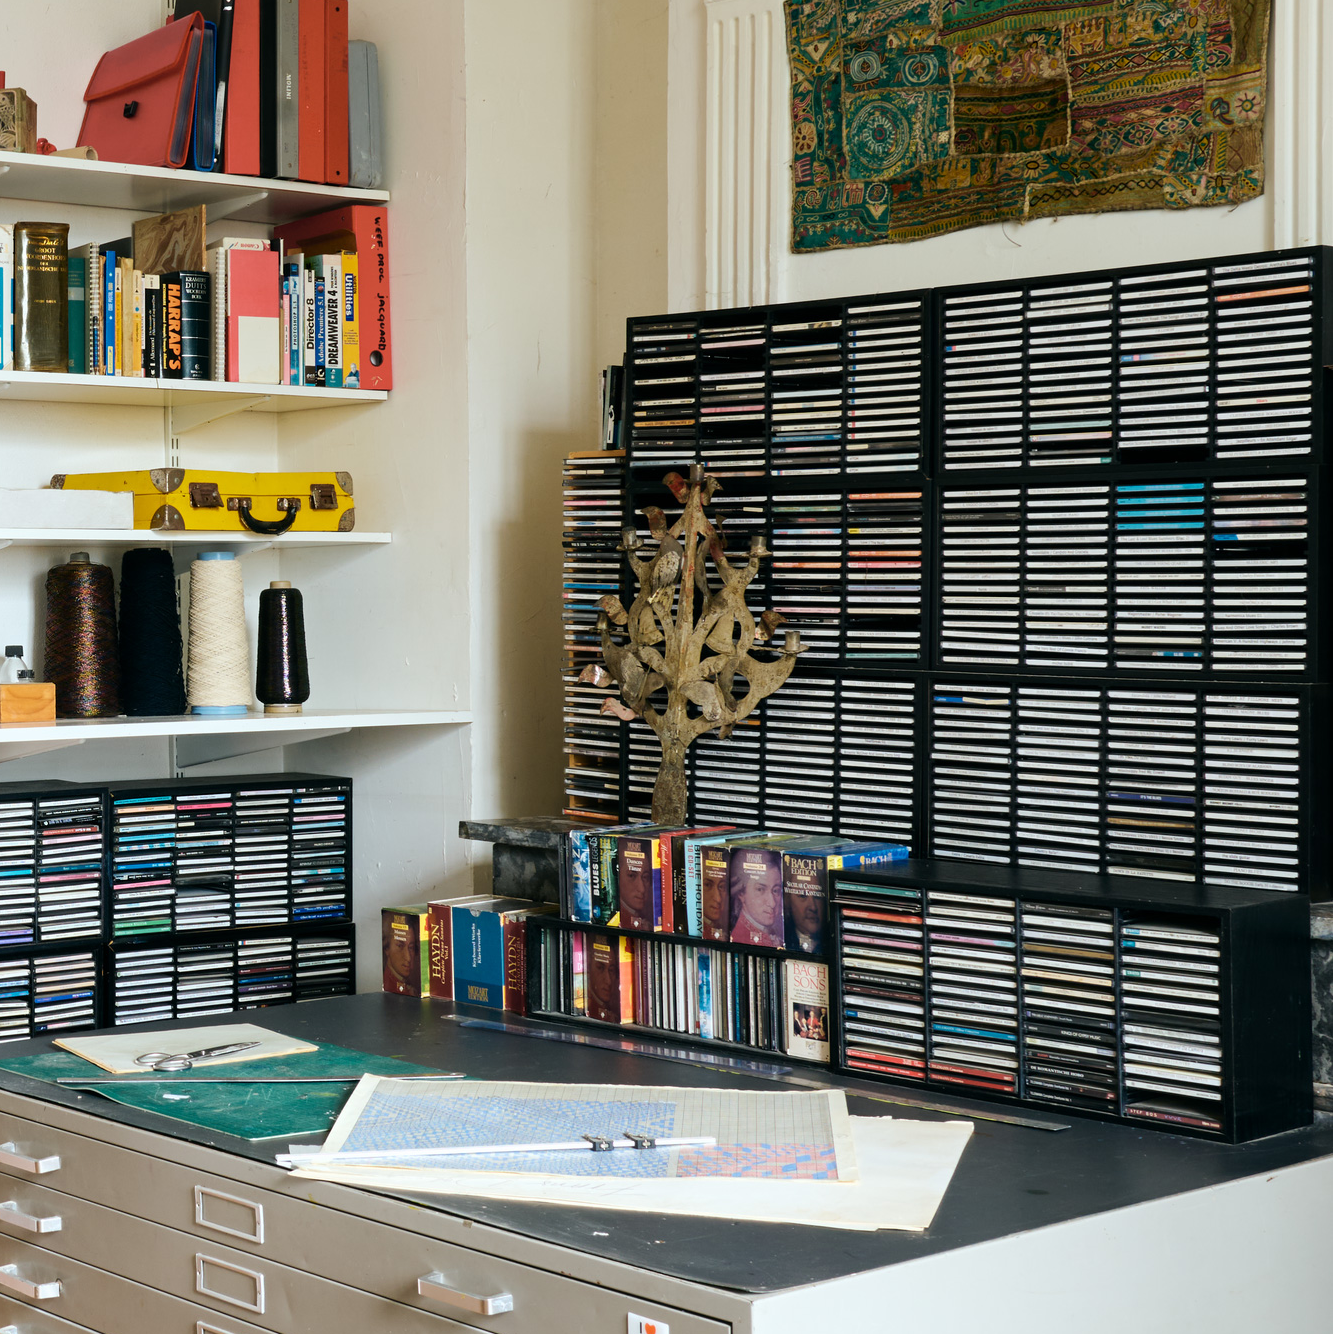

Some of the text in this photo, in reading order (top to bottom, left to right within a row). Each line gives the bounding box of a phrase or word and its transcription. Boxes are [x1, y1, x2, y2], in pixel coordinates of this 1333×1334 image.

[345, 275, 353, 316] Utilities
[167, 283, 181, 371] HARRAP'S
[306, 297, 314, 350] Director 8
[328, 298, 339, 365] DREAMWEAVER
[688, 844, 694, 853] 10
[588, 836, 600, 896] BLUES LEGENDS
[790, 858, 816, 869] BACH
[865, 855, 887, 865] BACH
[791, 868, 817, 877] EDITION
[694, 844, 703, 934] BILLIE HOLIDAY
[431, 923, 441, 978] HAYDN
[508, 934, 517, 991] HAYDN
[793, 962, 826, 979] BACH
[467, 984, 488, 996] MOZART
[793, 975, 826, 991] SONS
[1037, 1066, 1070, 1075] ROMANTISCHE
[639, 1321, 643, 1334] I
